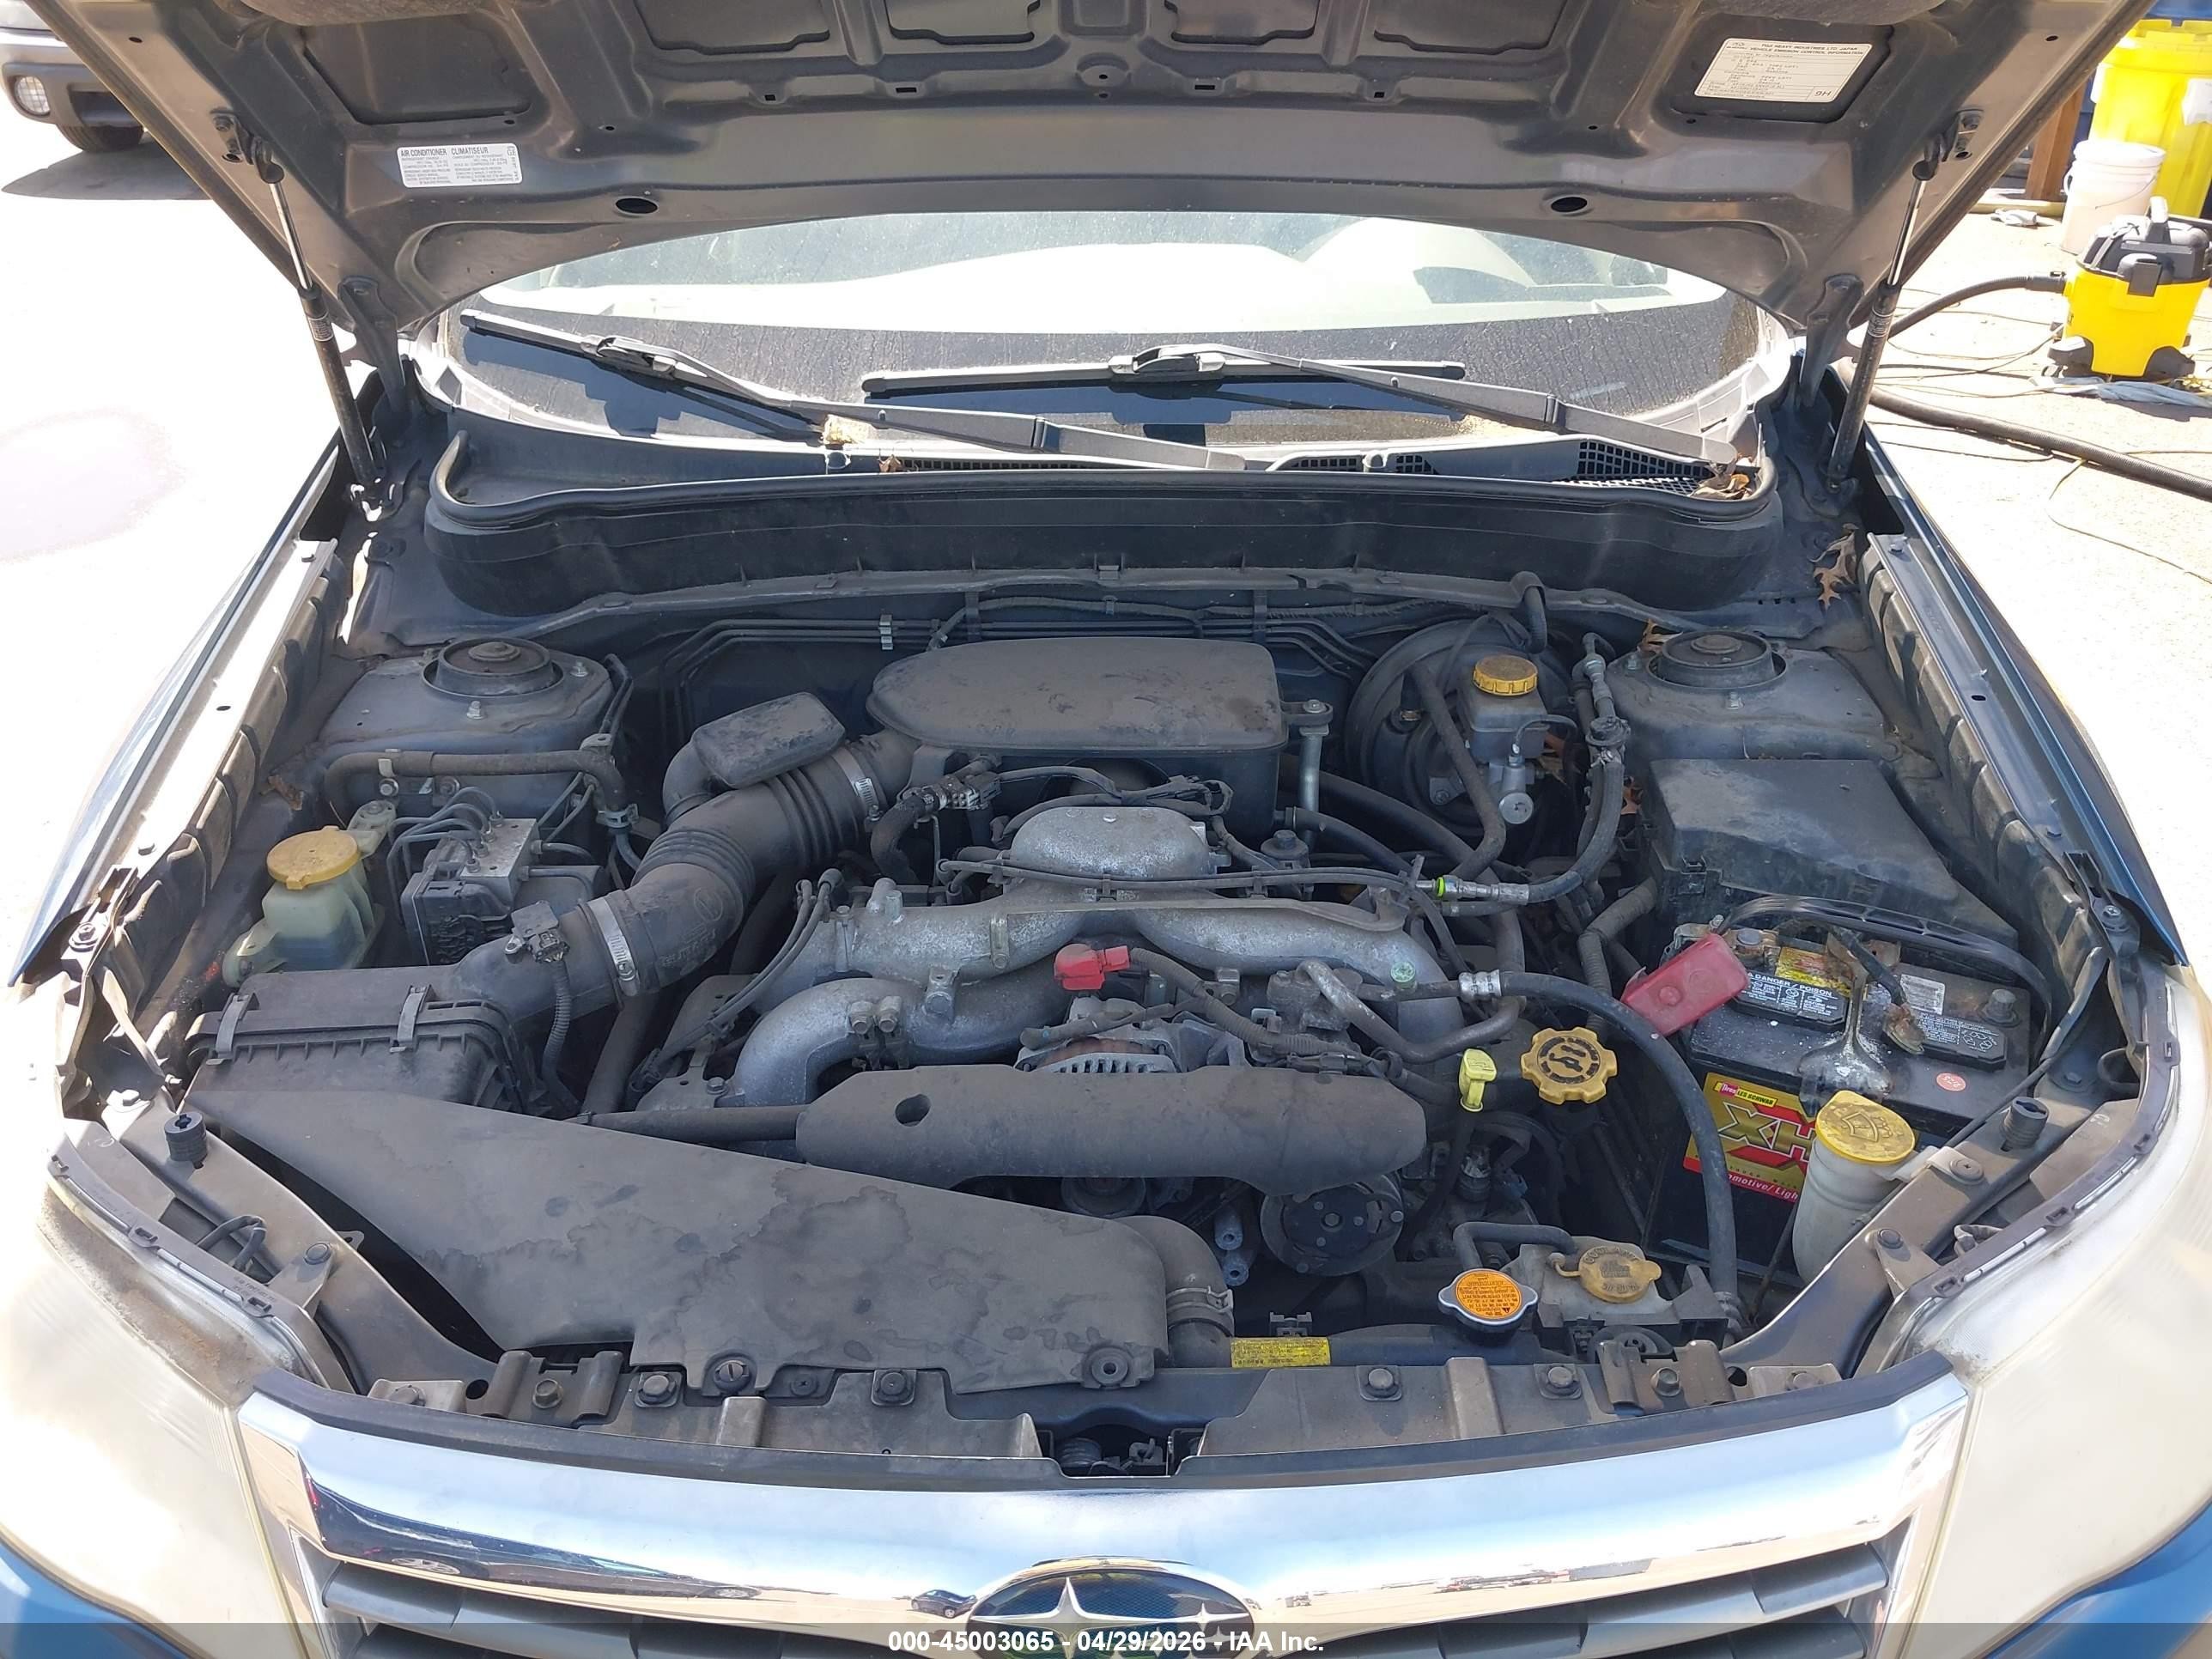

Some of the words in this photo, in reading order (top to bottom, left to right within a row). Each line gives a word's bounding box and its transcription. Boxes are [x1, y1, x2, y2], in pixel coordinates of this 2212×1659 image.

[410, 149, 447, 157] CONDITIONER
[1754, 974, 1791, 988] DANGER
[1800, 984, 1832, 997] POISON
[1738, 1090, 1748, 1098] LES
[1747, 1093, 1775, 1106] SCHWAB
